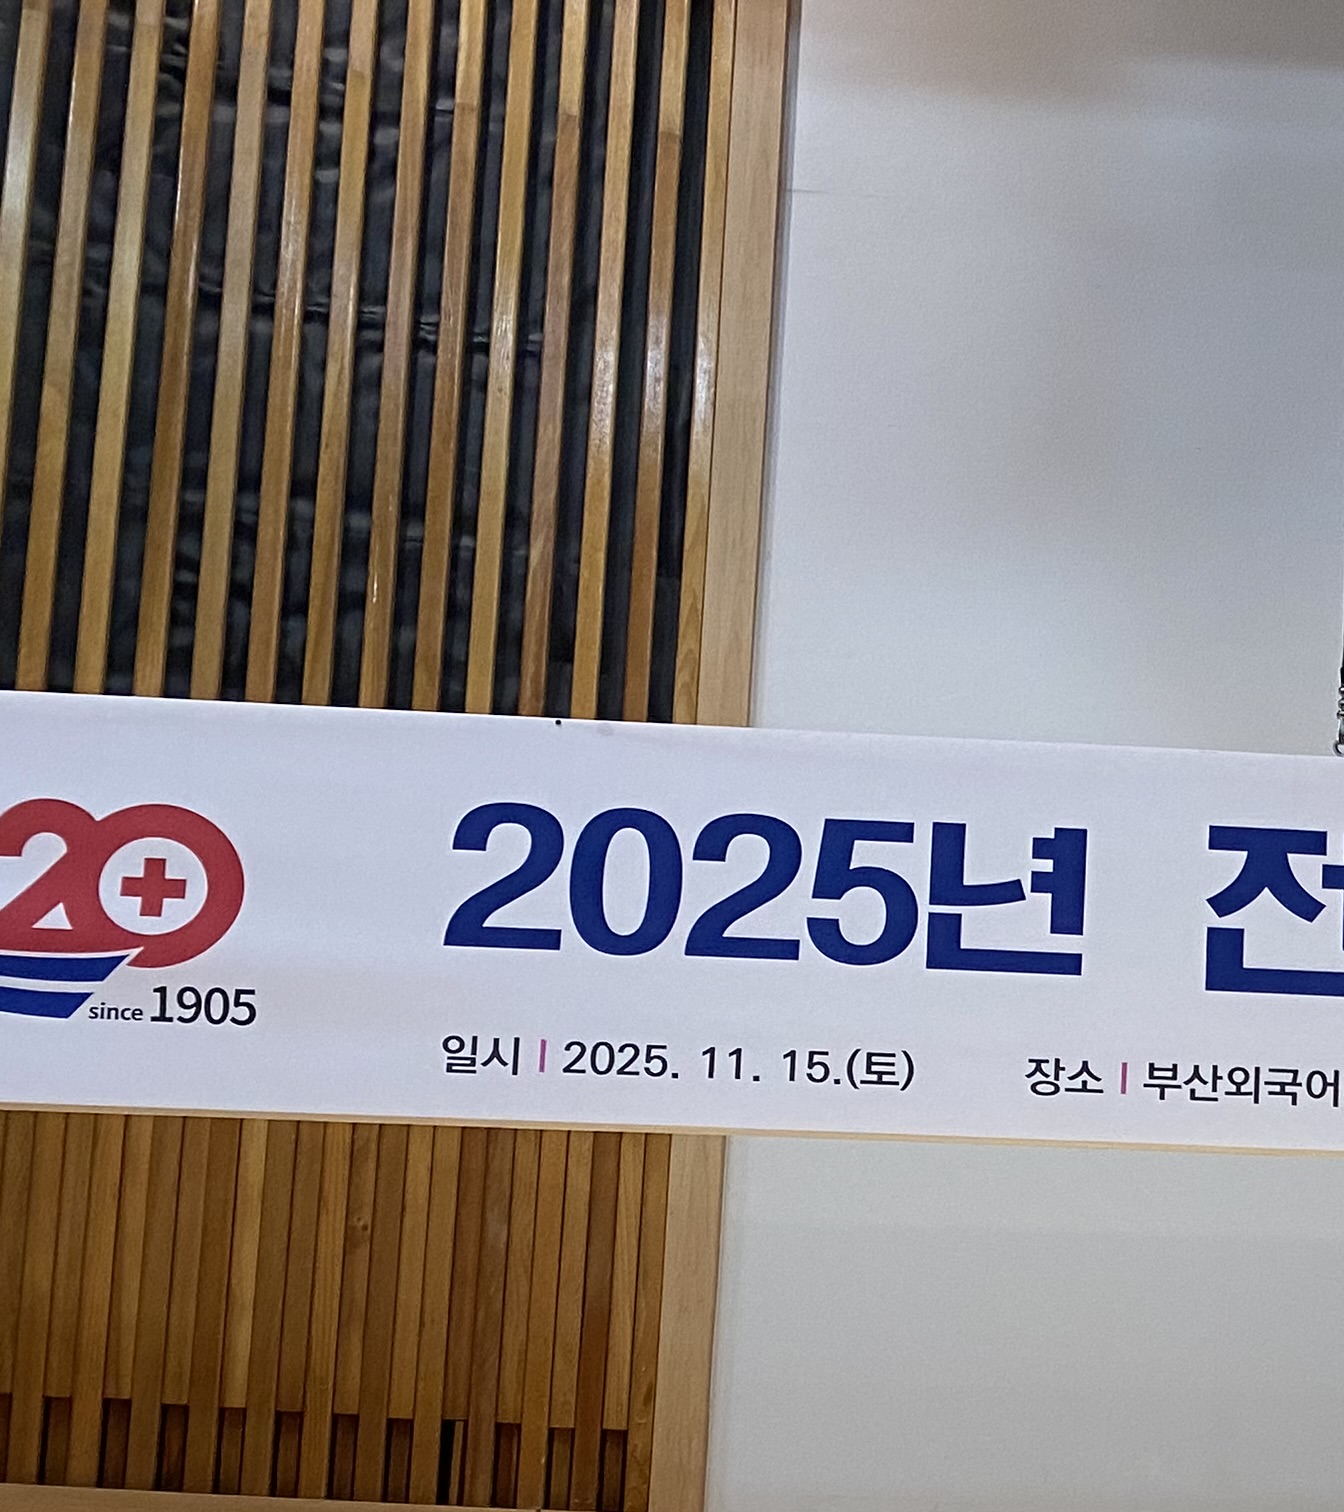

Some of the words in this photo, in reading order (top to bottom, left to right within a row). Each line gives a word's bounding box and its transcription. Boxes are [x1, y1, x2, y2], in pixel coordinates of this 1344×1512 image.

[443, 803, 1087, 975] 2025년
[88, 1003, 143, 1021] since
[151, 986, 256, 1025] 1905
[443, 1036, 520, 1075] 일시
[563, 1041, 678, 1078] 2025.
[702, 1047, 760, 1081] 11.
[783, 1049, 914, 1091] 15.(토)
[1025, 1058, 1103, 1096] 장소
